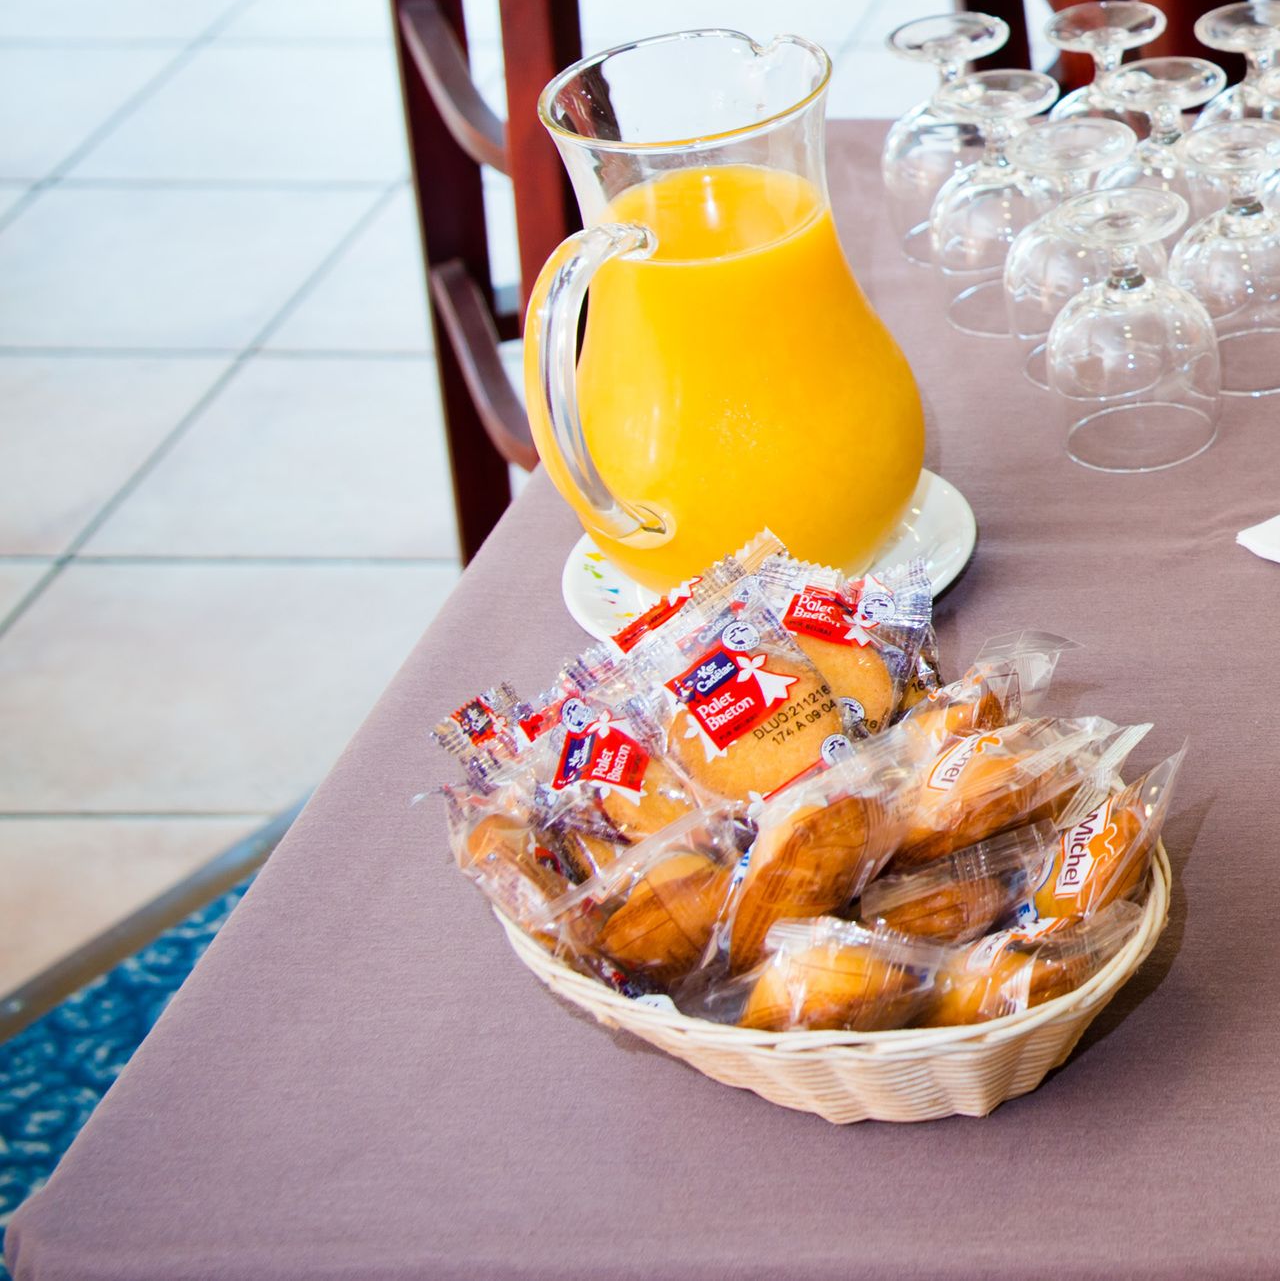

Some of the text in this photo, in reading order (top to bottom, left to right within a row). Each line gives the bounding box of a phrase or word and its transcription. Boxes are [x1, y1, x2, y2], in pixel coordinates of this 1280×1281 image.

[696, 661, 736, 693] Cadélac
[696, 691, 736, 720] Palet
[705, 696, 756, 732] Breton
[795, 720, 807, 732] A
[591, 748, 615, 778] Palet
[606, 744, 632, 783] Breton
[1062, 812, 1099, 887] Michel
